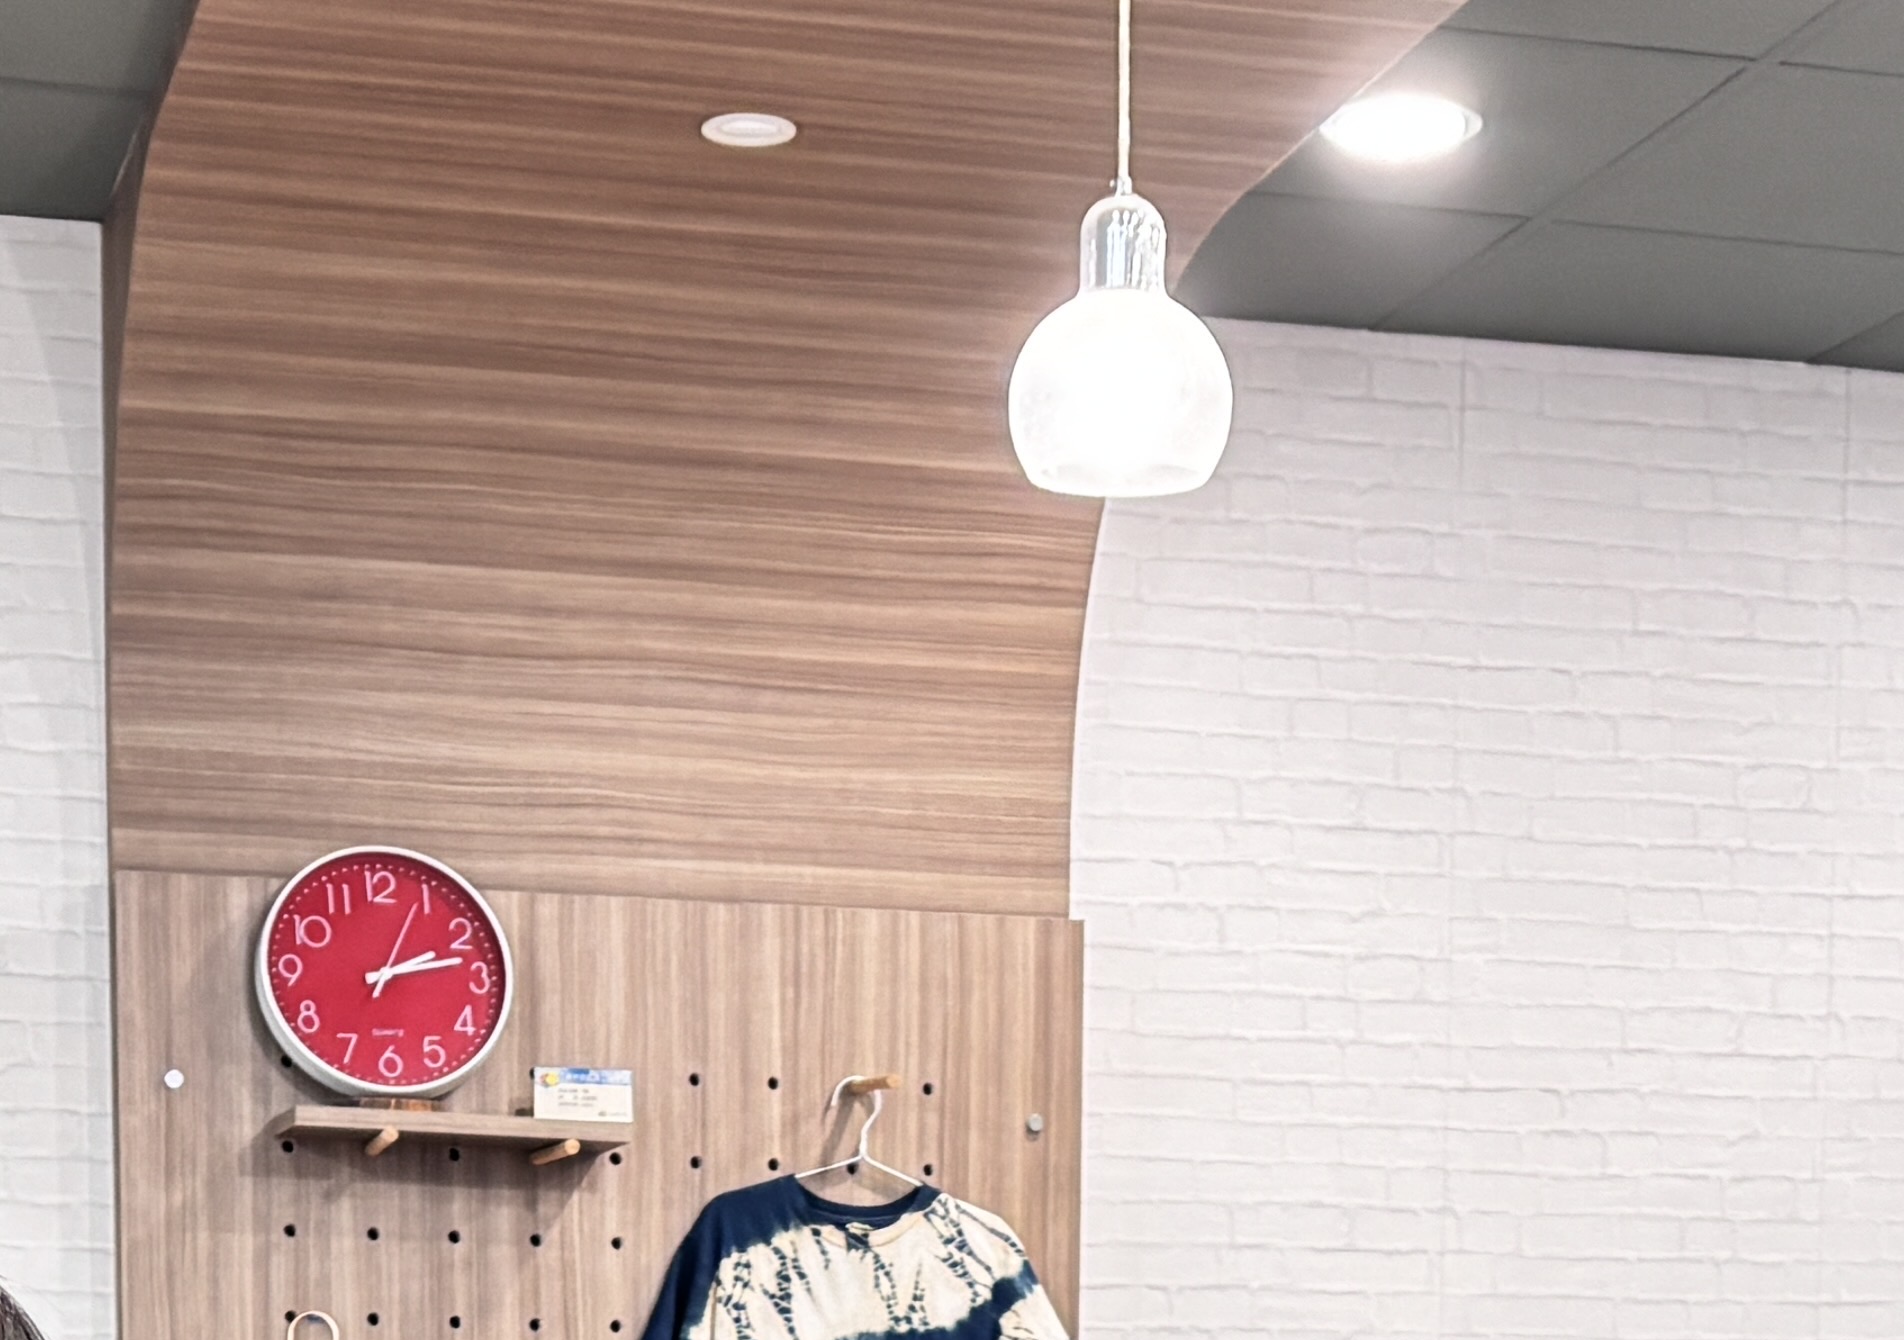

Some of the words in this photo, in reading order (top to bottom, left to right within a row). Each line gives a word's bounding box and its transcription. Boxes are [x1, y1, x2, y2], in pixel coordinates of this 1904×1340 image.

[326, 882, 351, 915] 11
[364, 870, 398, 904] 12
[421, 882, 432, 915] 1
[293, 914, 332, 948] 10
[448, 917, 473, 950] 2
[278, 953, 303, 987] 9
[469, 961, 491, 994] 3
[297, 1000, 320, 1033] 8
[454, 1004, 477, 1036] 4
[336, 1033, 358, 1064] 7
[378, 1045, 404, 1078] 6
[422, 1036, 446, 1068] 5
